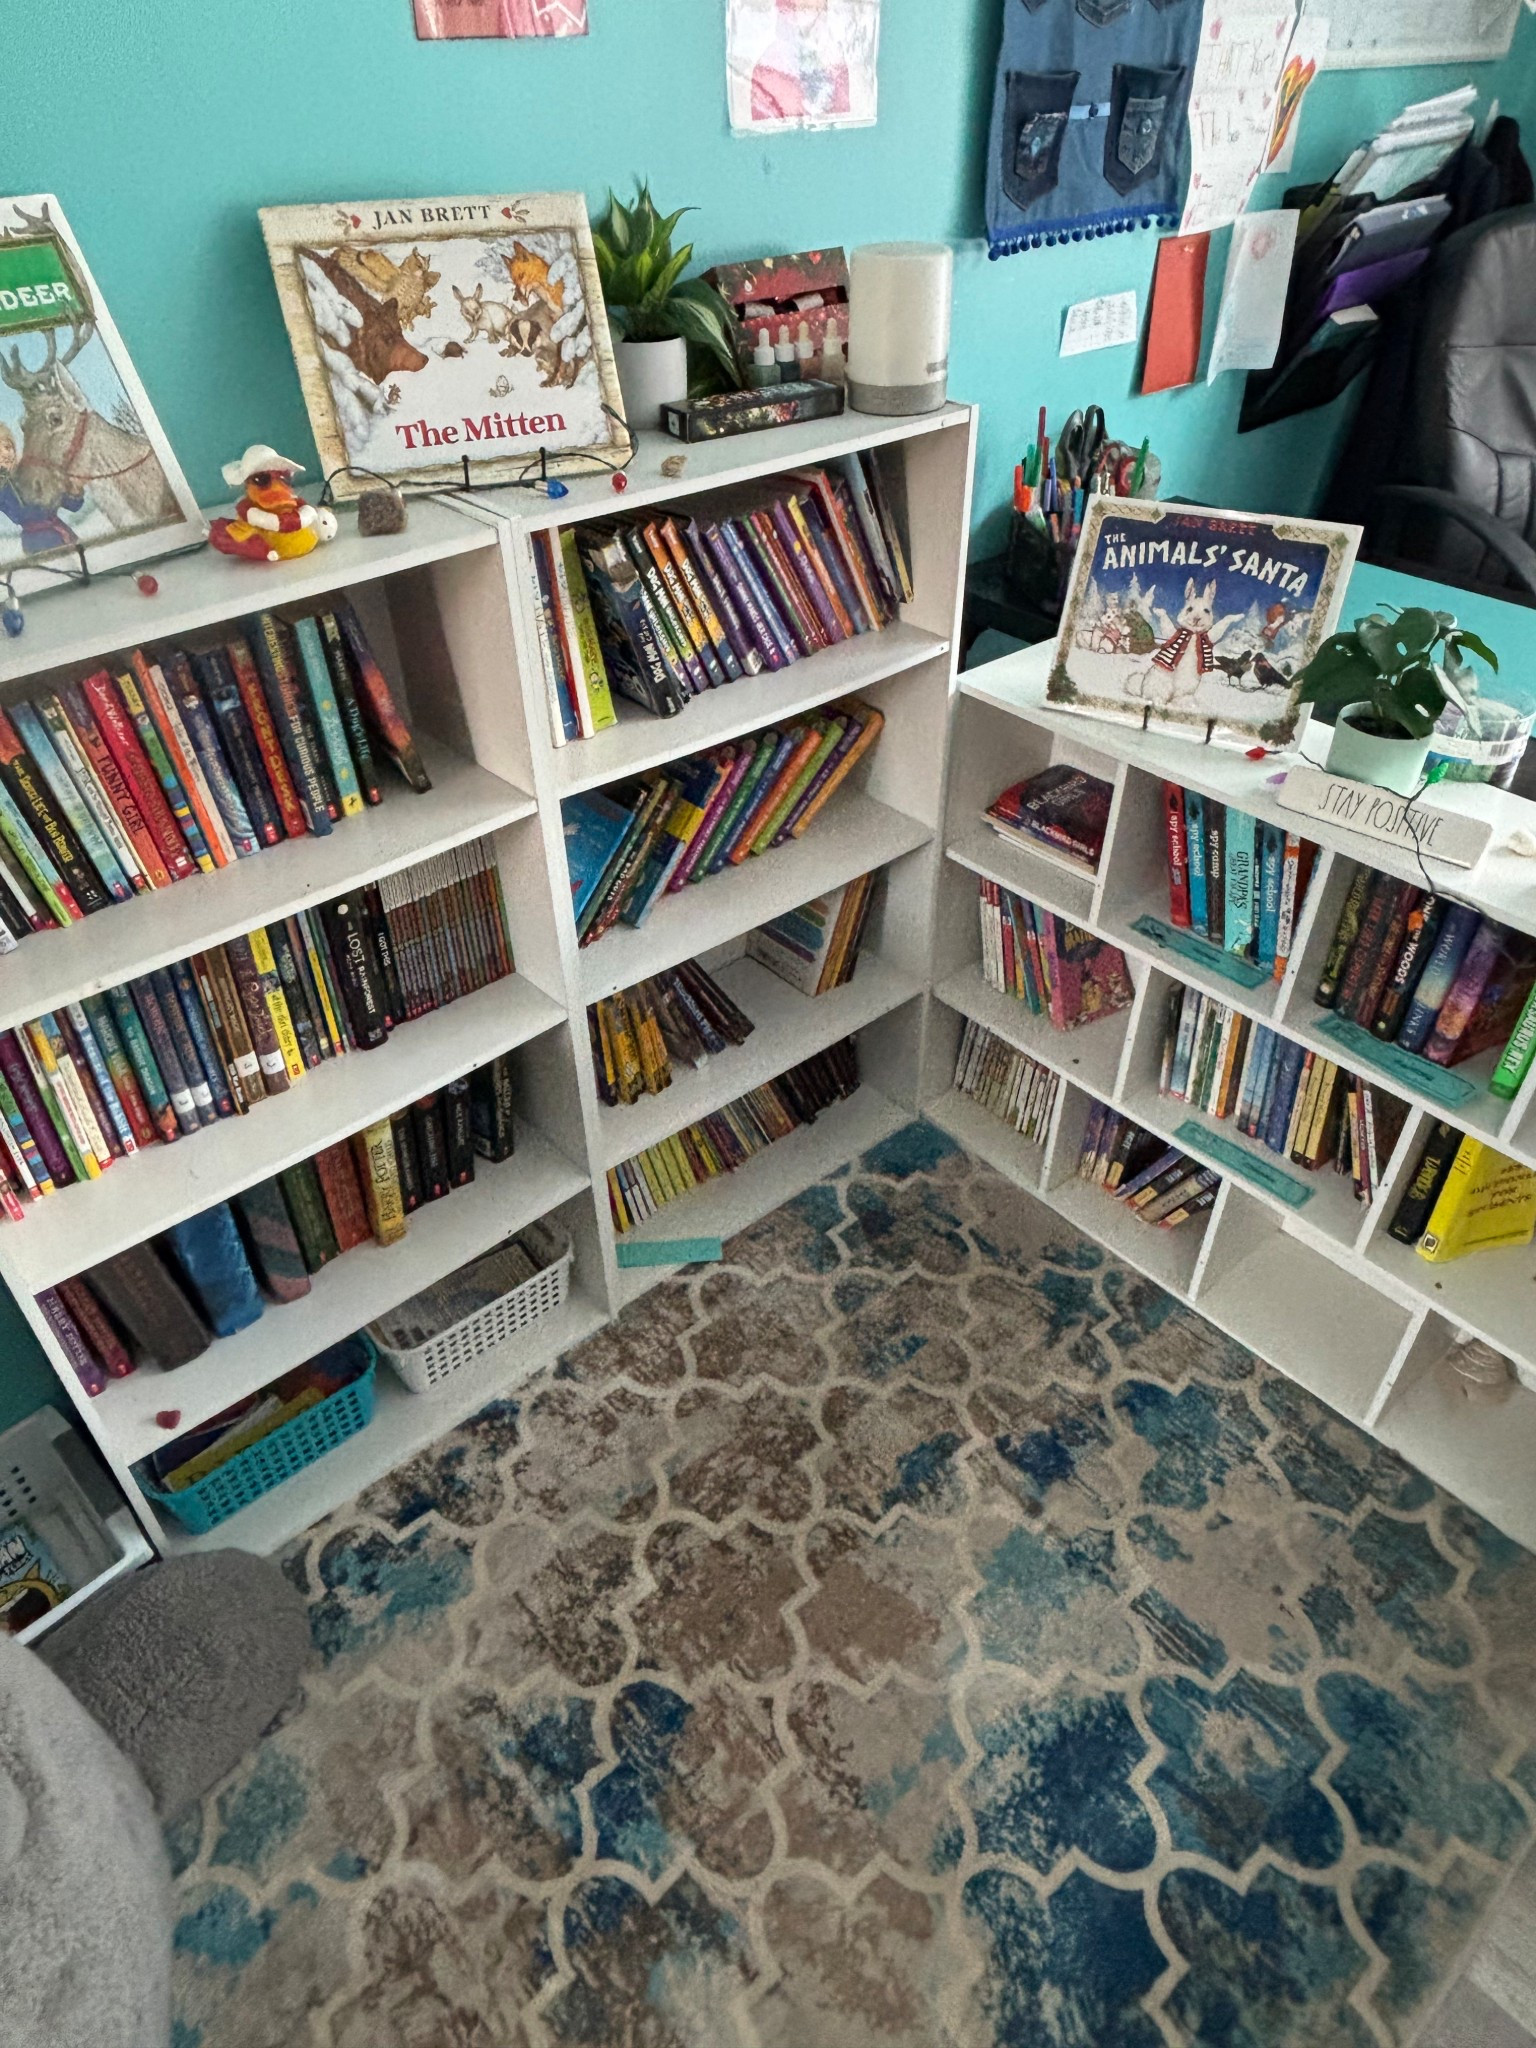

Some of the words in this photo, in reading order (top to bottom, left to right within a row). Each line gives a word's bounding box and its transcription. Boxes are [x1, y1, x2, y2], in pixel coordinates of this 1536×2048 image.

[372, 208, 413, 230] JAN
[421, 205, 491, 223] BRETT
[396, 419, 459, 449] The
[462, 410, 567, 442] Mitten
[1104, 533, 1126, 544] THE
[661, 561, 679, 585] DOG
[679, 558, 696, 580] DOG
[1102, 540, 1227, 570] ANIMALS'
[1228, 549, 1309, 598] SANTA
[644, 566, 663, 591] DOG
[654, 587, 670, 608] MAN
[642, 642, 659, 663] MAN
[648, 661, 667, 683] DOG
[288, 714, 303, 734] FOR
[294, 736, 315, 775] CURIOUS
[306, 776, 325, 812] PEOPLE
[120, 803, 146, 836] GIRL
[1168, 815, 1178, 832] spy
[1318, 783, 1367, 819] STAY
[1364, 797, 1444, 847] POSITIVE
[1189, 823, 1200, 841] spy
[1210, 830, 1219, 848] spy
[1191, 843, 1203, 876] school
[1210, 849, 1219, 878] camp
[1265, 877, 1278, 911] school
[346, 931, 365, 964] LOST
[1391, 940, 1420, 984] WOODS
[355, 965, 376, 1014] RAINFOREST
[368, 1140, 390, 1183] POTTER
[376, 1185, 398, 1220] HARRY
[44, 1296, 71, 1332] HARRY
